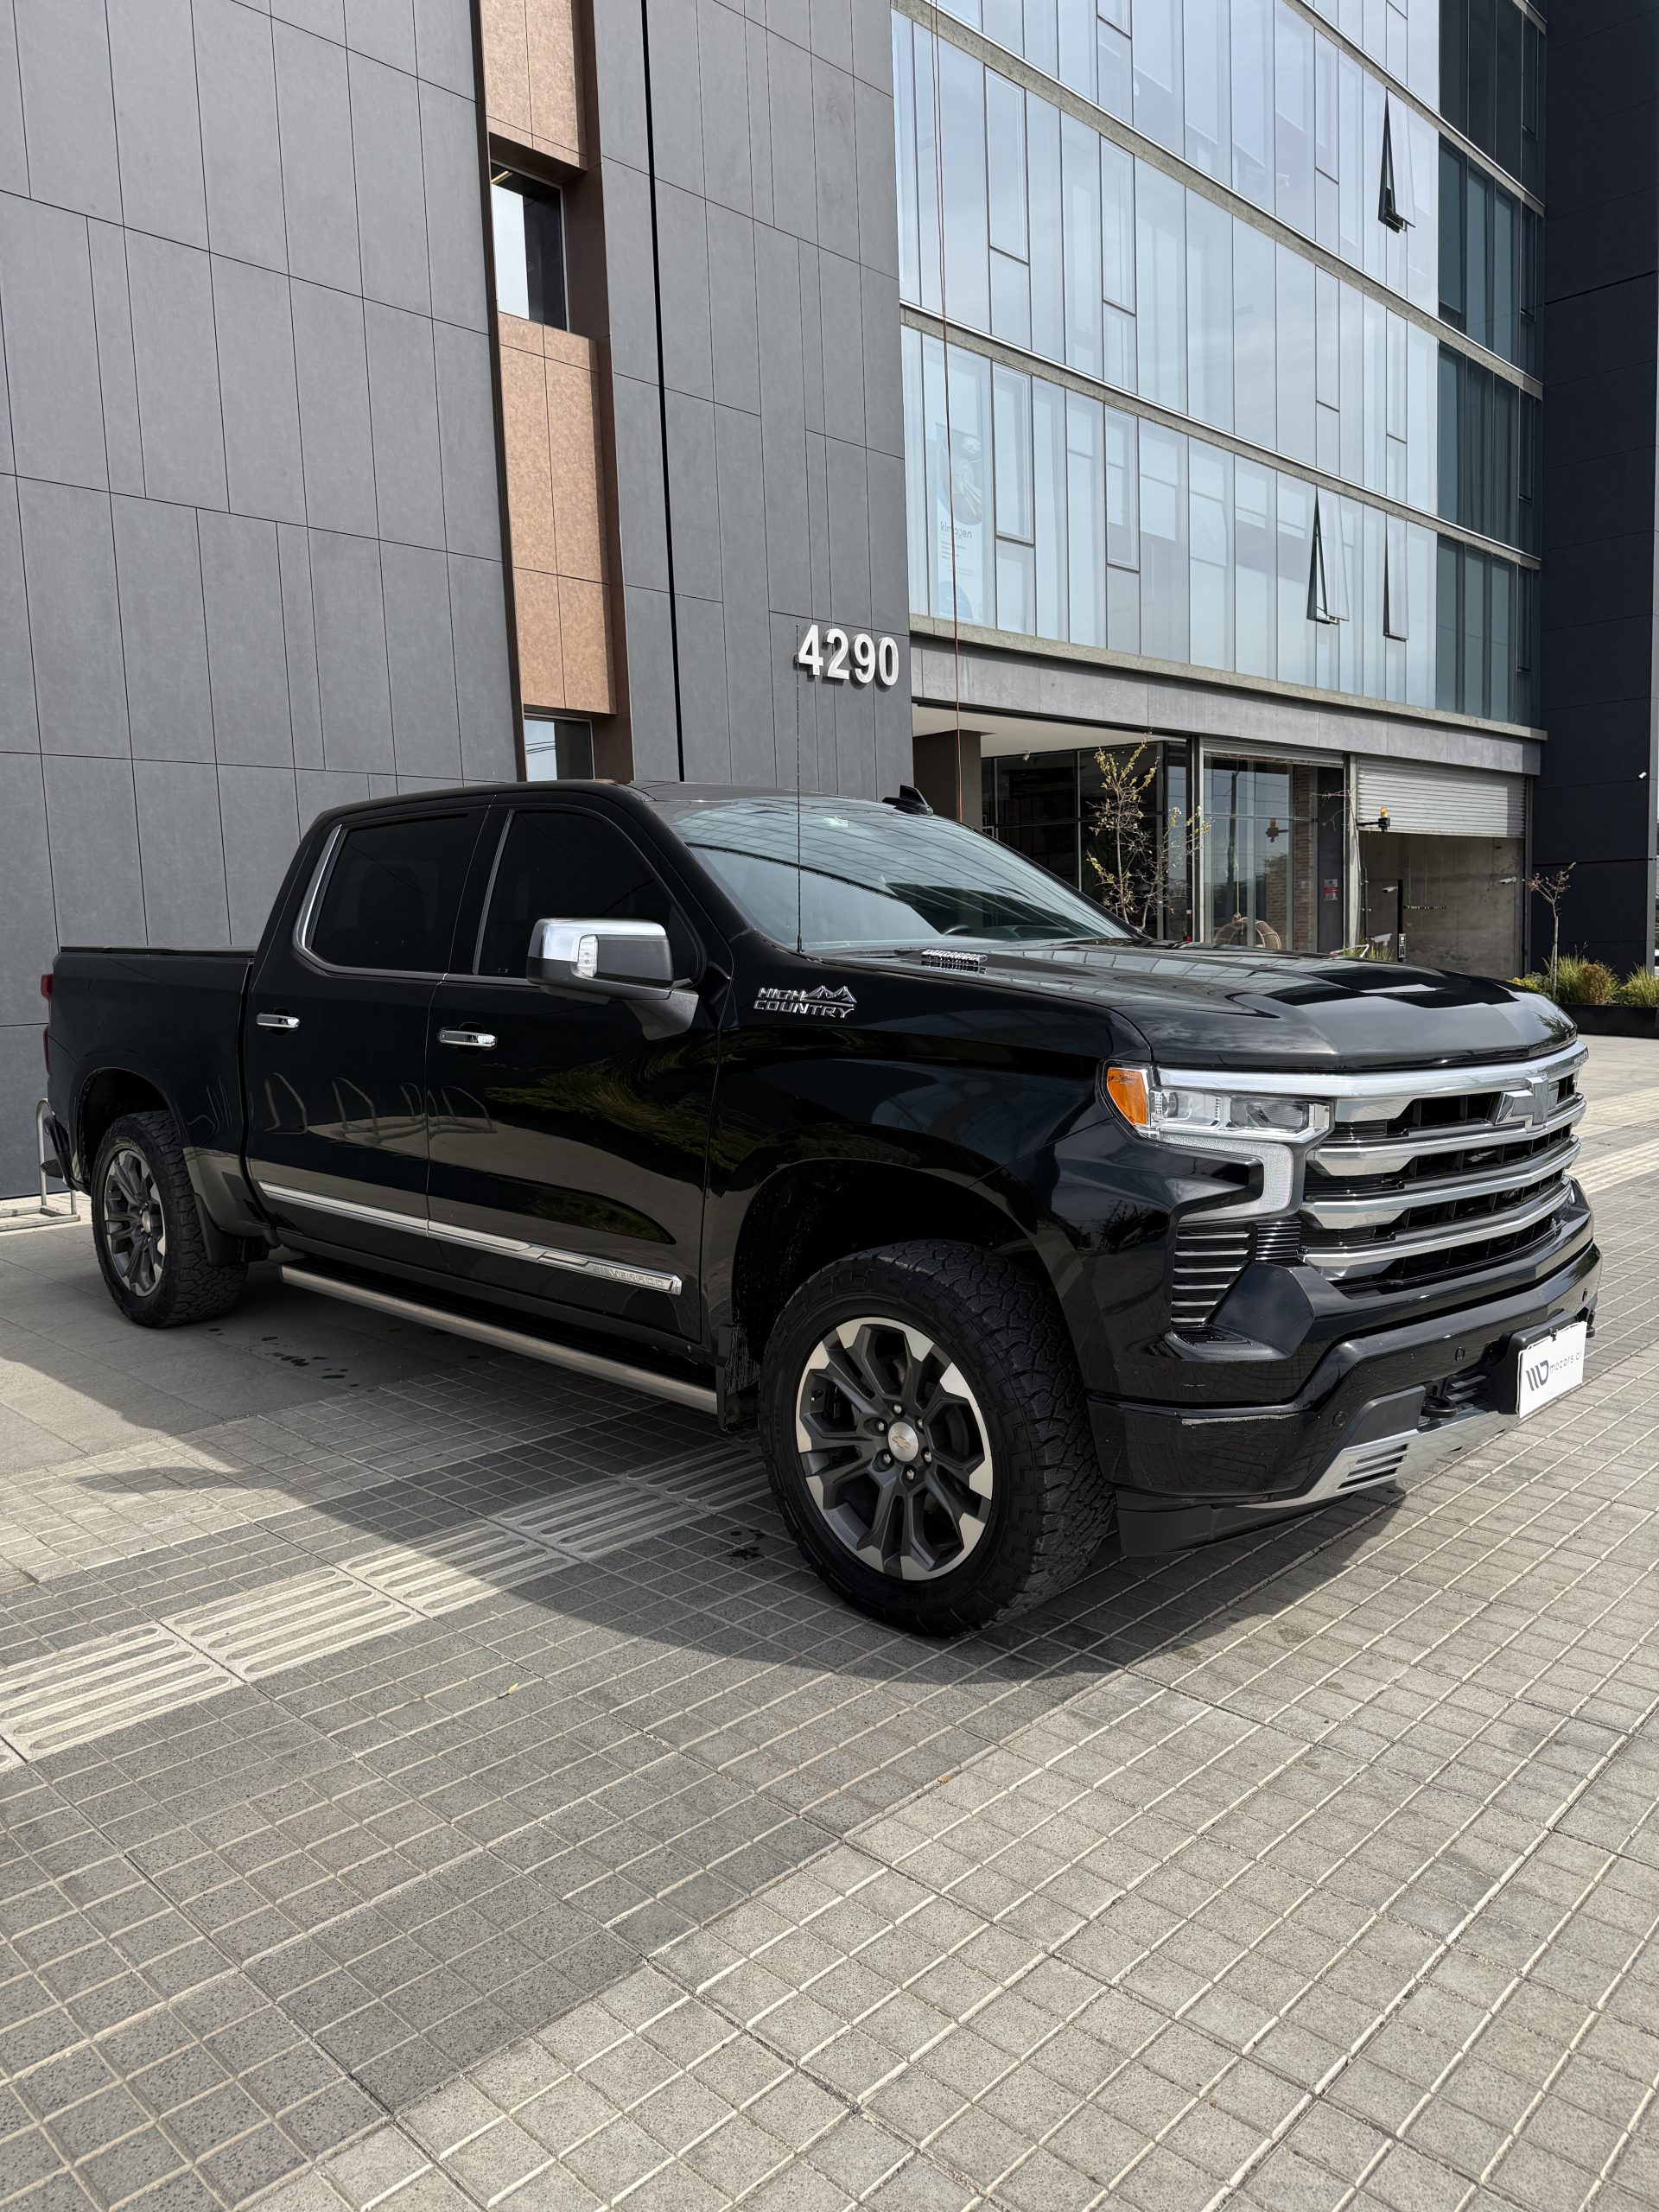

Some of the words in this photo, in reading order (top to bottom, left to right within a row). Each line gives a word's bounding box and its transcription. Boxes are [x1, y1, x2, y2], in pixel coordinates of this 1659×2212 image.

[797, 624, 899, 686] 4290
[757, 987, 809, 1001] HIGH
[753, 1000, 855, 1019] COUNTRY
